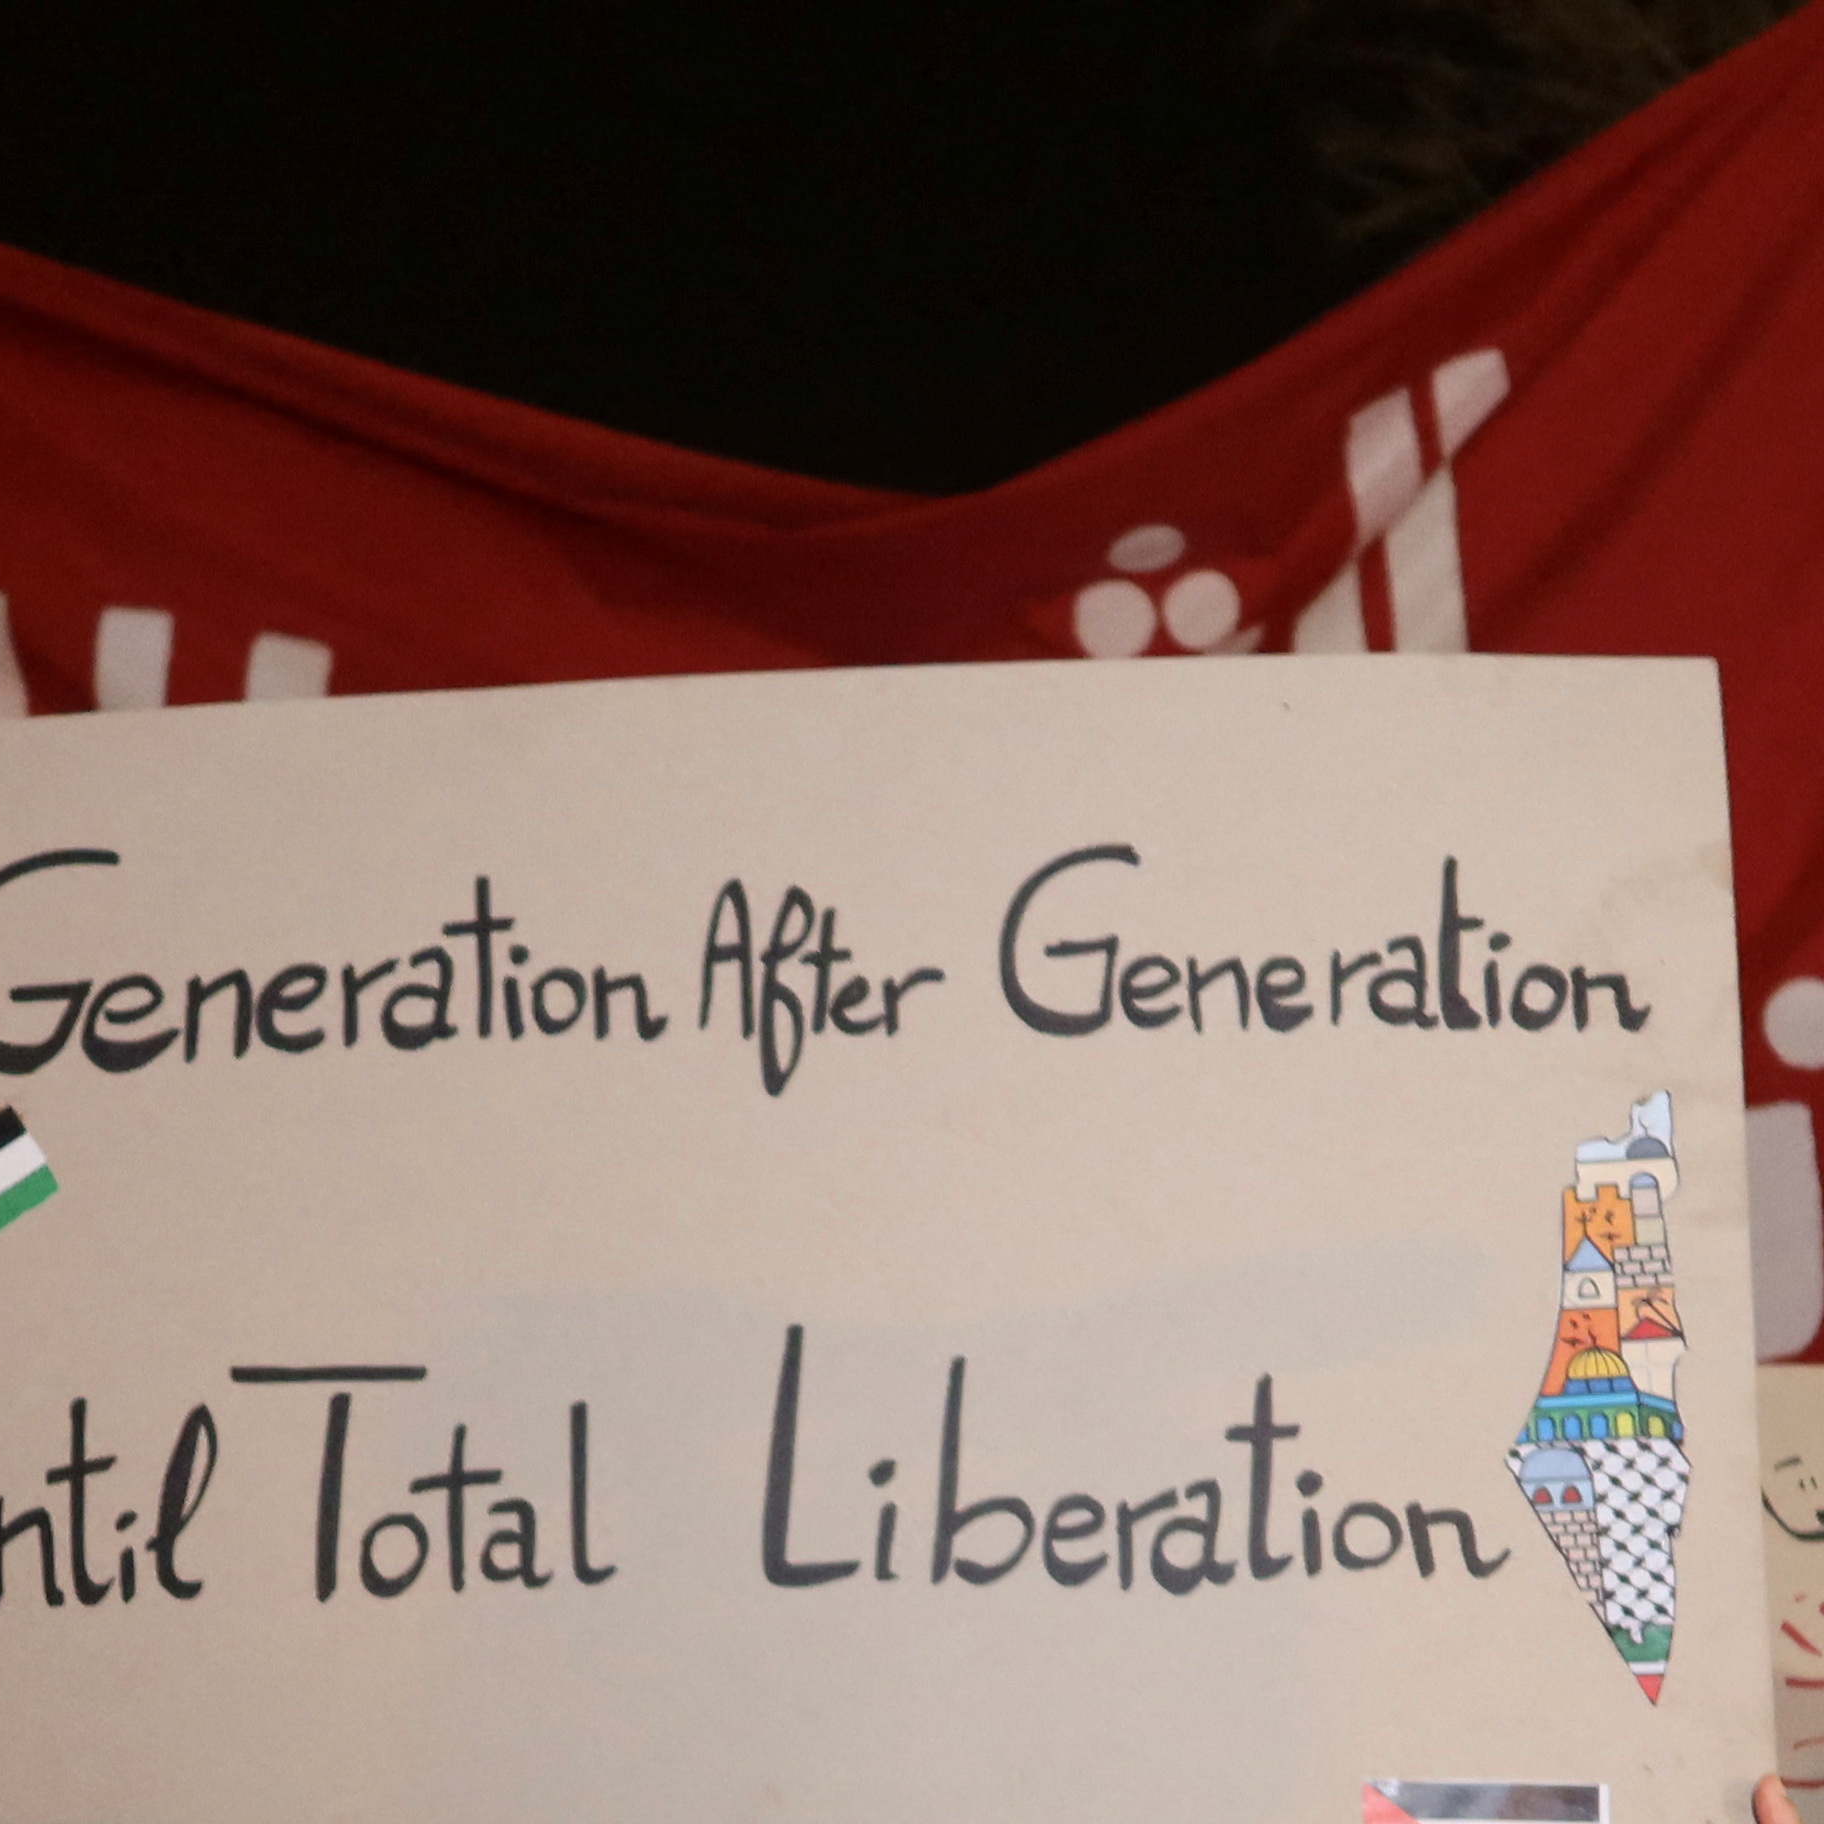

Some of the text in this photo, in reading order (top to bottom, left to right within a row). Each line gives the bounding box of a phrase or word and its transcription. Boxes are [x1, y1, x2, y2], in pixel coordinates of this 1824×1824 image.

[699, 879, 944, 1096] After
[999, 845, 1650, 1037] Generation
[229, 1365, 616, 1604] Total
[762, 1325, 1511, 1595] Liberation
